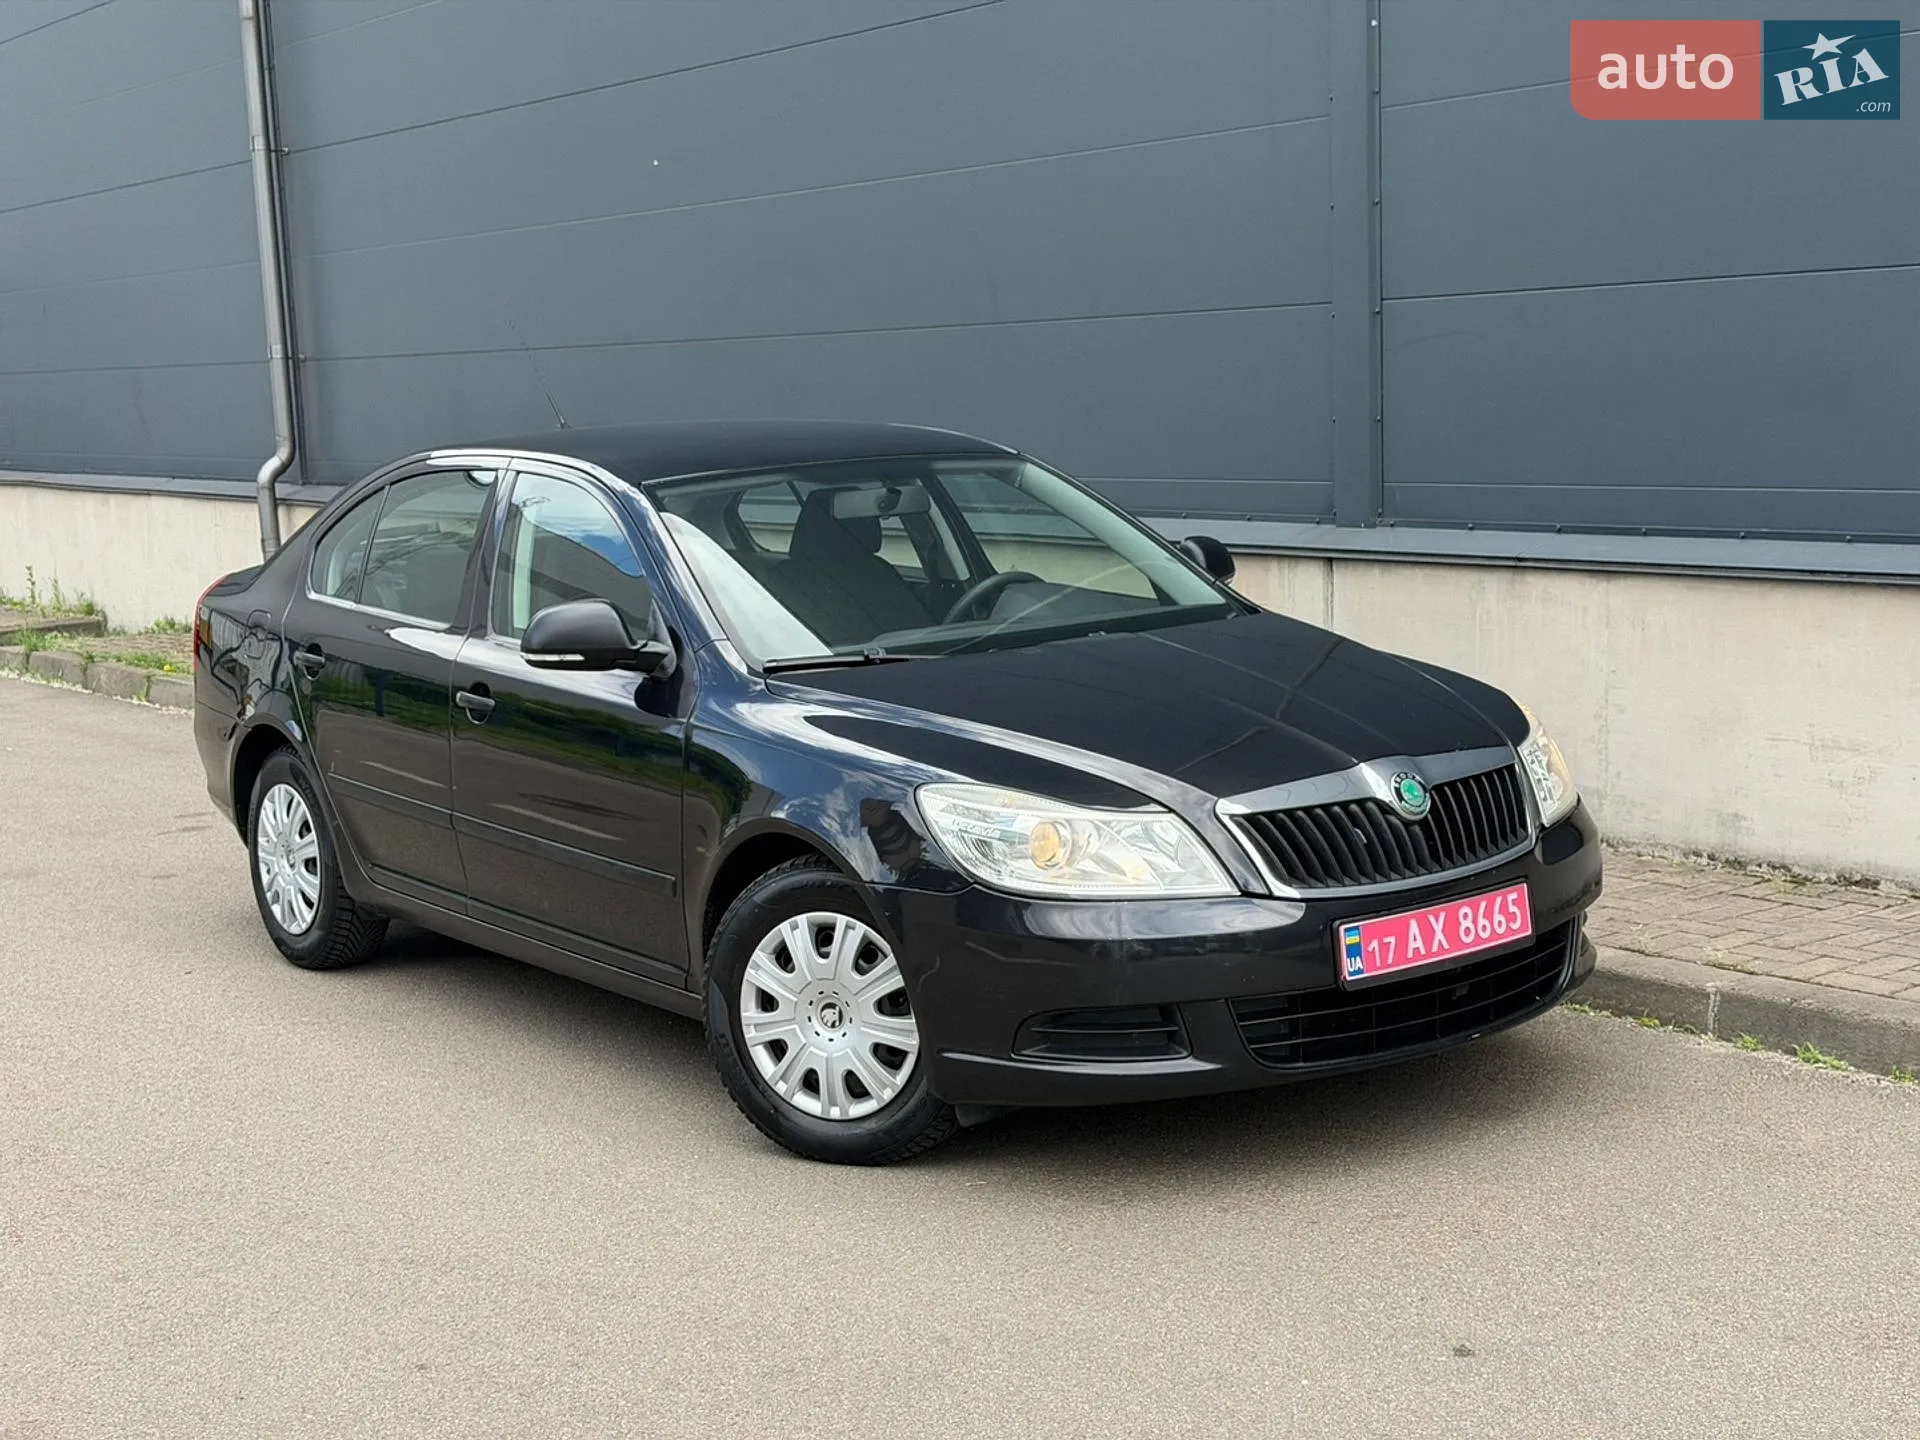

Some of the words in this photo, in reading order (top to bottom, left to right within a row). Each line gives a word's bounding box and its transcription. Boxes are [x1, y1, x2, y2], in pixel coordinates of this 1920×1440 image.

[1366, 935, 1397, 968] 17
[1406, 911, 1451, 959] AX
[1457, 893, 1522, 944] 8665
[1347, 957, 1363, 972] UA
